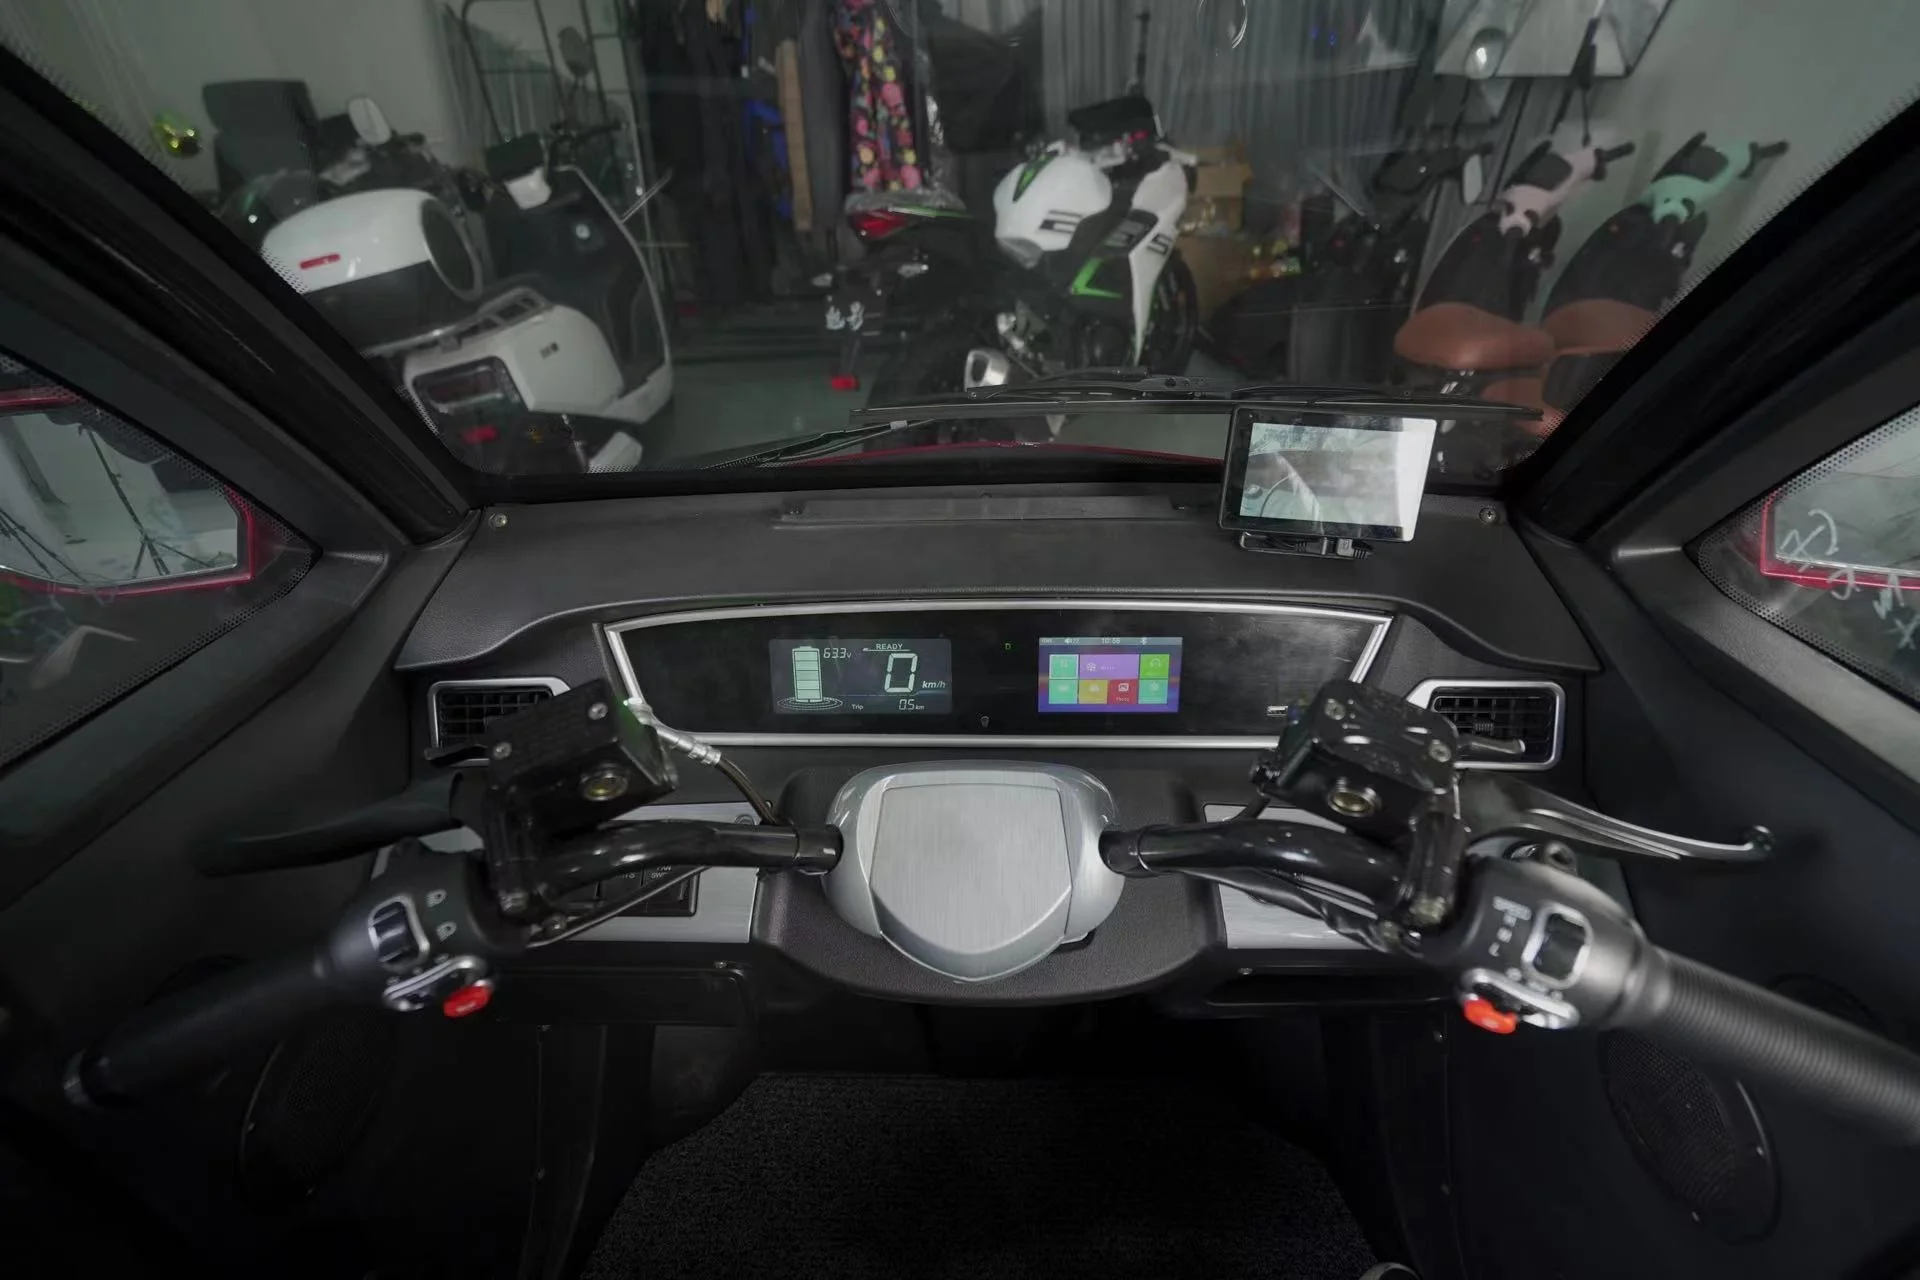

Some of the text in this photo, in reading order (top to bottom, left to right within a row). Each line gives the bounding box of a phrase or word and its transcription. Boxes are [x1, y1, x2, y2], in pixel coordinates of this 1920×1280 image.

[884, 653, 918, 693] 0
[922, 680, 946, 689] km/h
[851, 703, 864, 711] Trip
